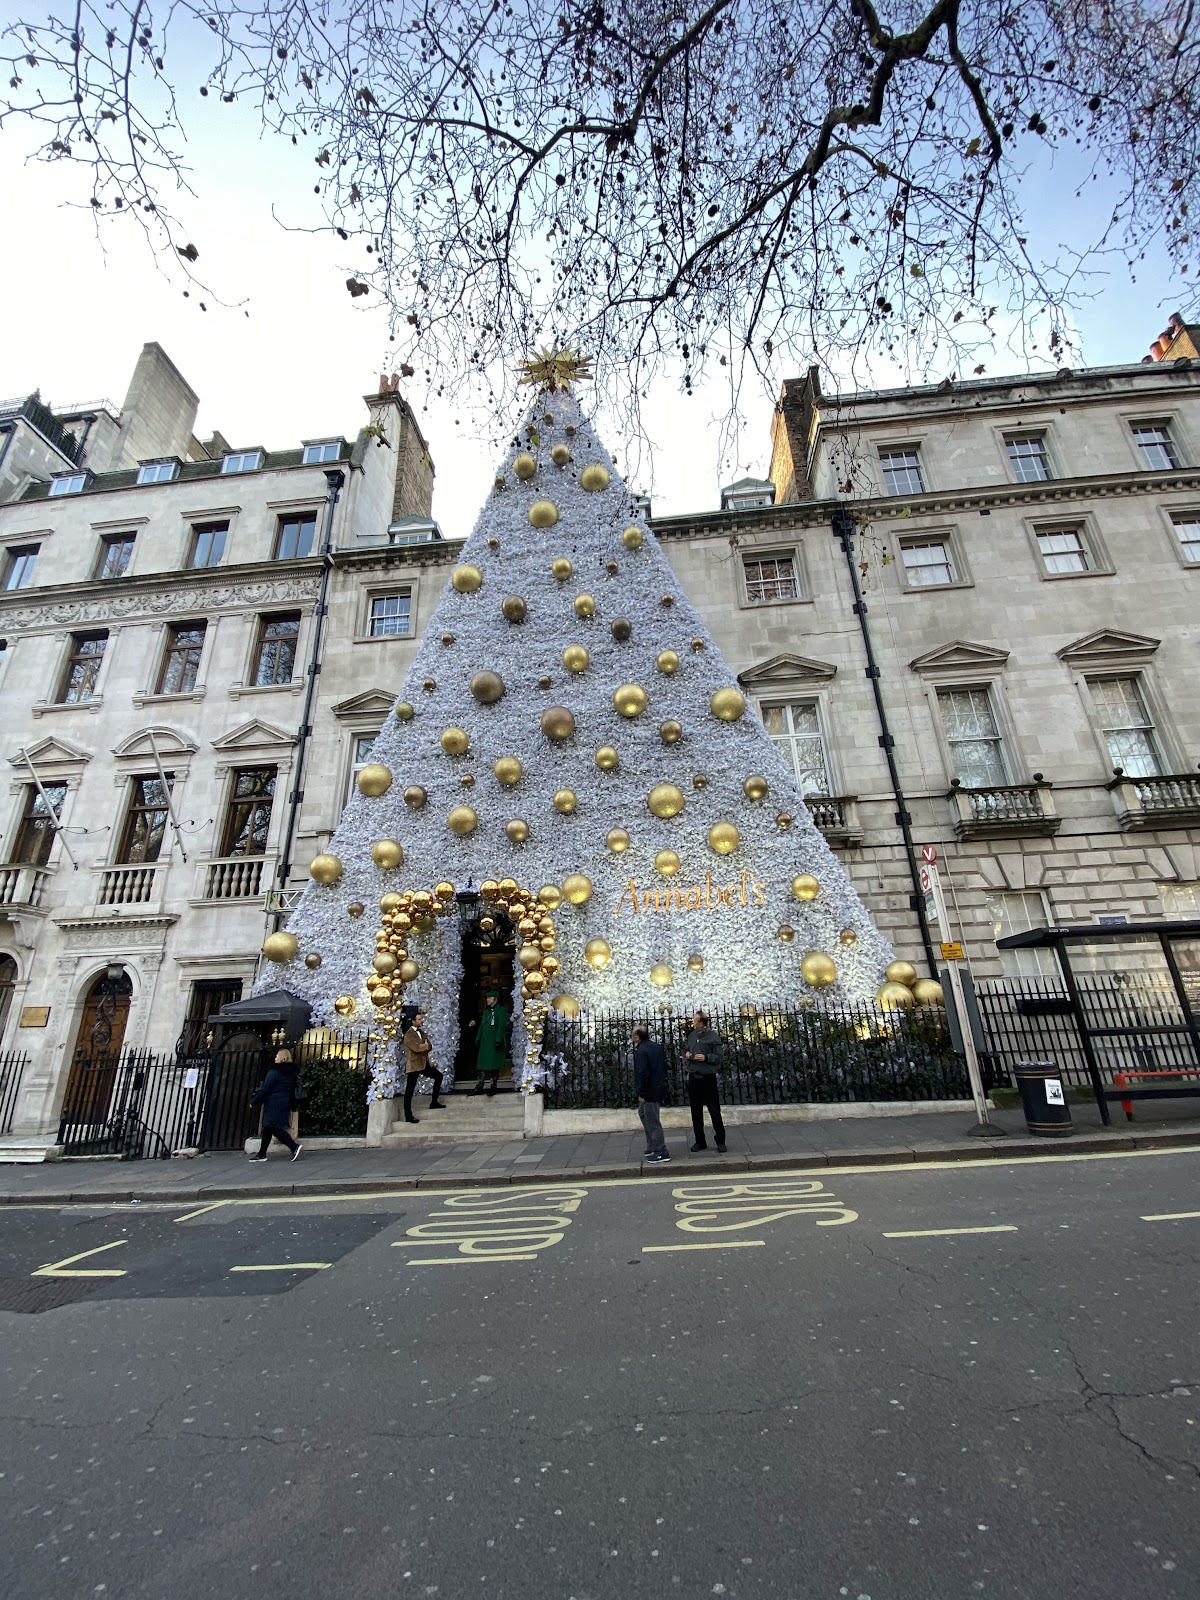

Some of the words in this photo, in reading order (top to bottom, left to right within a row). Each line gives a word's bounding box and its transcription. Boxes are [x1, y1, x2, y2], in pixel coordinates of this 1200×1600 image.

[923, 848, 932, 860] V
[613, 869, 766, 916] Annabel's
[391, 1189, 588, 1255] STOP
[671, 1181, 859, 1232] BUS
